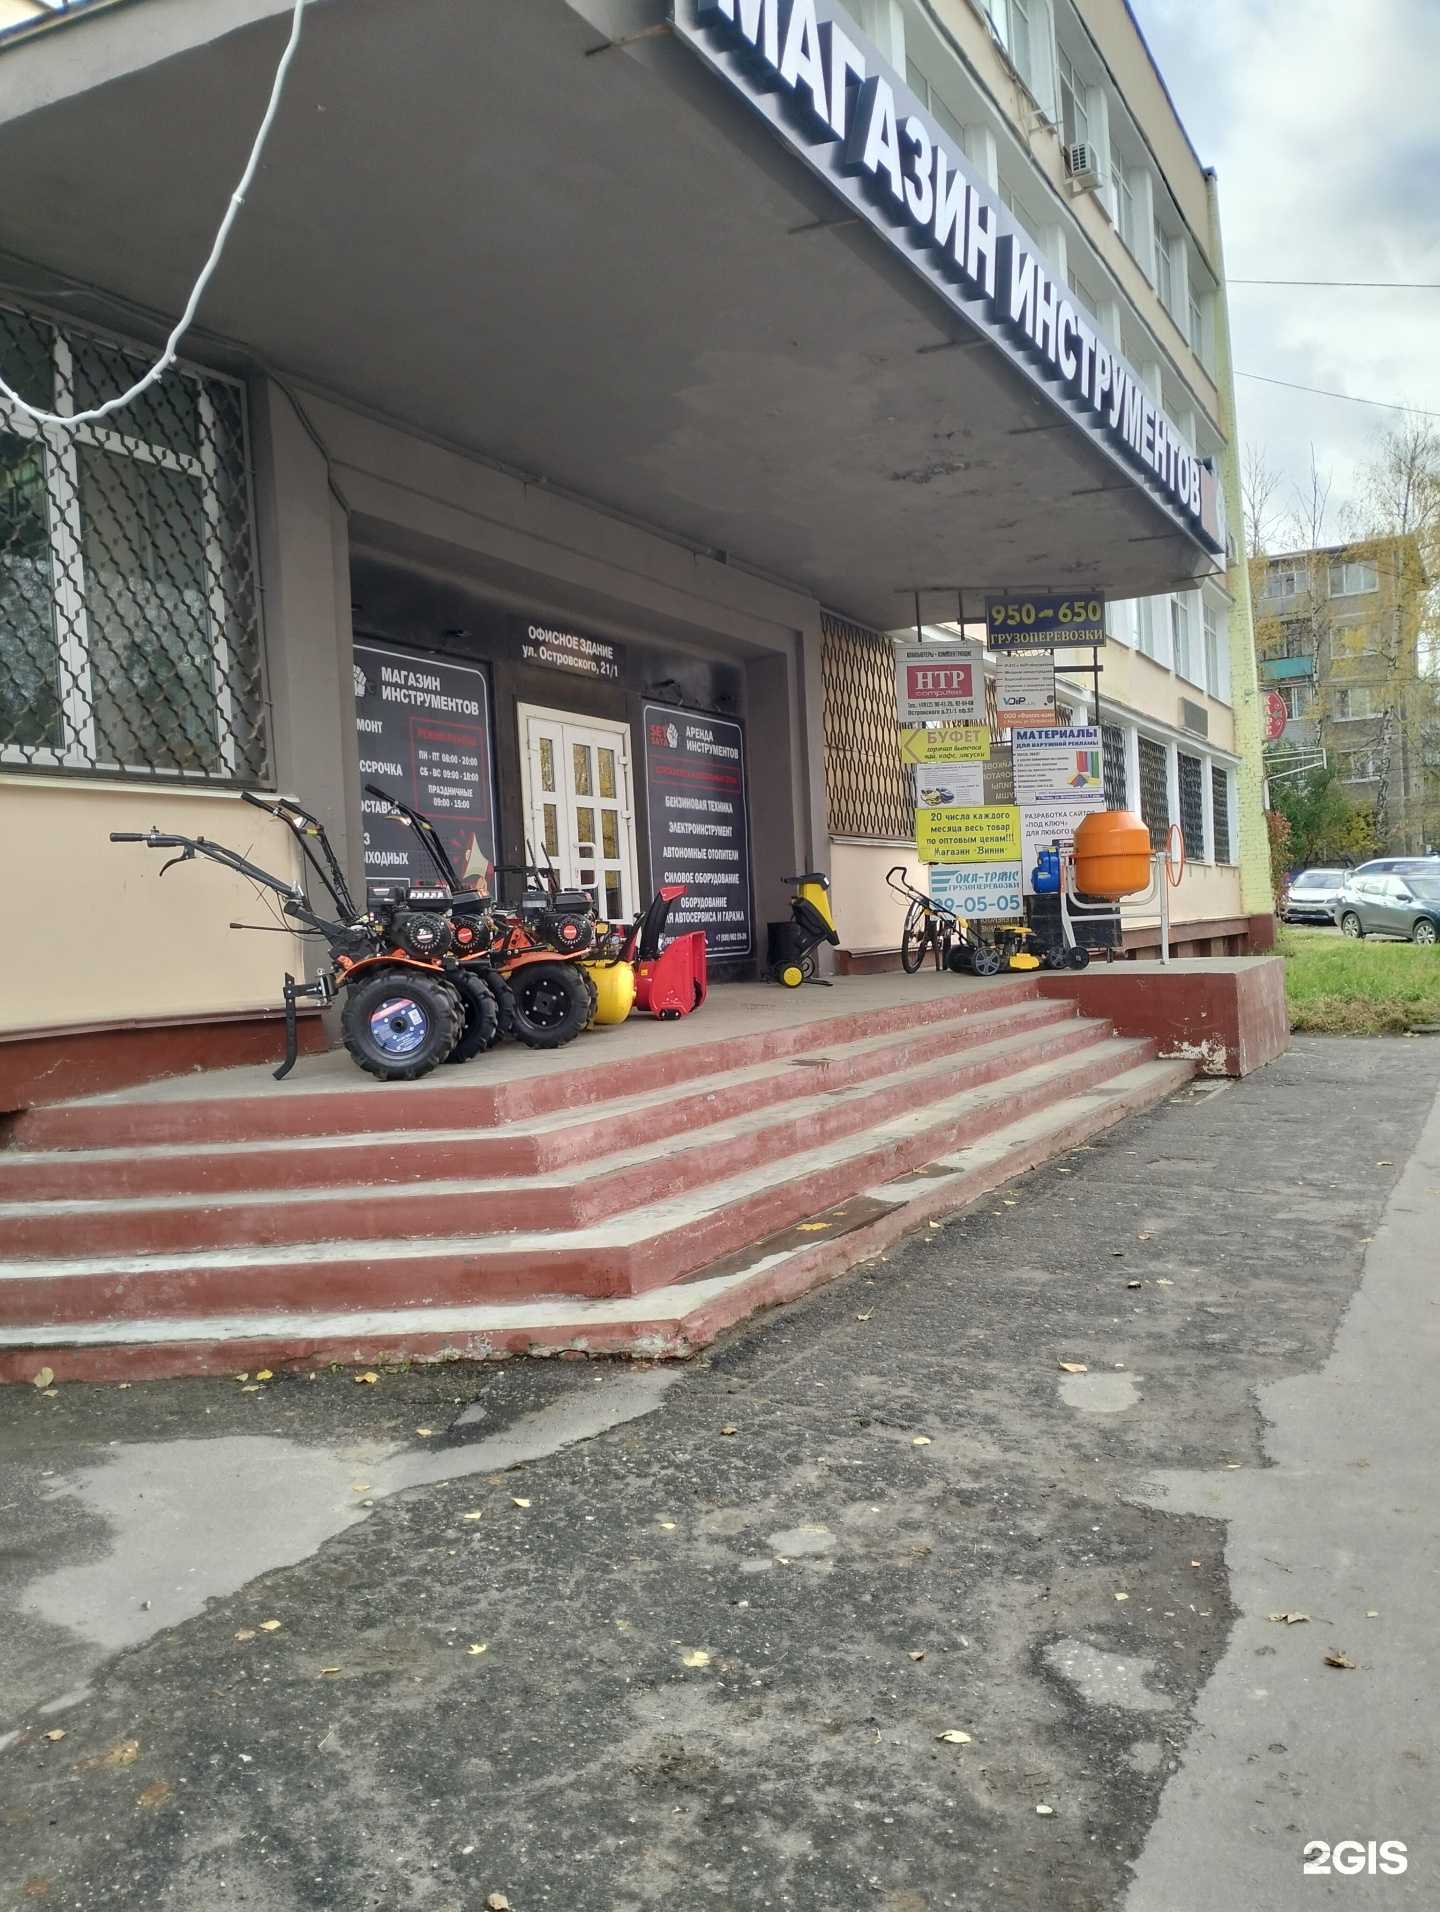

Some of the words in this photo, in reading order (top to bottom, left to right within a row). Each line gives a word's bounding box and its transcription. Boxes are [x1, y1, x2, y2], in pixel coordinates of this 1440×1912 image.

[1010, 234, 1201, 518] ИНСТРУМЕНТОВ
[528, 625, 579, 649] ОФИСНОЕ
[580, 639, 614, 659] ЗДАНИЕ
[990, 629, 1104, 644] ГРУЗОПЕРЕВОЗКИ
[522, 645, 537, 658] ул.
[539, 646, 600, 674] Островского,
[600, 661, 618, 678] 21/1
[381, 666, 441, 691] МАГАЗИН
[382, 685, 480, 715] ИНСТРУМЕНТОВ
[685, 726, 714, 742] АРЕНДА
[927, 730, 981, 744] БУФЕТ
[1016, 729, 1098, 740] МАТЕРИАЛЫ
[686, 740, 739, 759] ИНСТРУМЕНТОВ
[359, 760, 403, 777] ССРОЧКА
[665, 796, 707, 812] БЕНЗИНОВАЯ
[708, 800, 733, 814] ТЕХНИКА
[930, 812, 942, 821] 20
[973, 812, 1010, 820] каждого
[1025, 811, 1067, 819] РАЗРАБОТКА
[669, 822, 733, 837] ЭЛЕКТРОИНСТРУМЕНТ
[930, 826, 962, 834] месяца
[987, 824, 1010, 832] товар
[1040, 828, 1070, 836] ЛЮБОГО
[938, 836, 977, 844] оптовым
[663, 847, 707, 859] АВТОНОМНЫЕ
[708, 849, 739, 861] ОТОПИТЕЛИ
[664, 872, 694, 883] СИЛОВОЕ
[695, 873, 740, 885] ОБОРУДОВАНИЕ
[955, 871, 1019, 884] ОКА-ТРАНС
[680, 897, 727, 909] ОБОРУДОВАНИЕ
[675, 912, 716, 924] АВТОСЕРВИСА
[722, 911, 745, 921] ГАРАЖА
